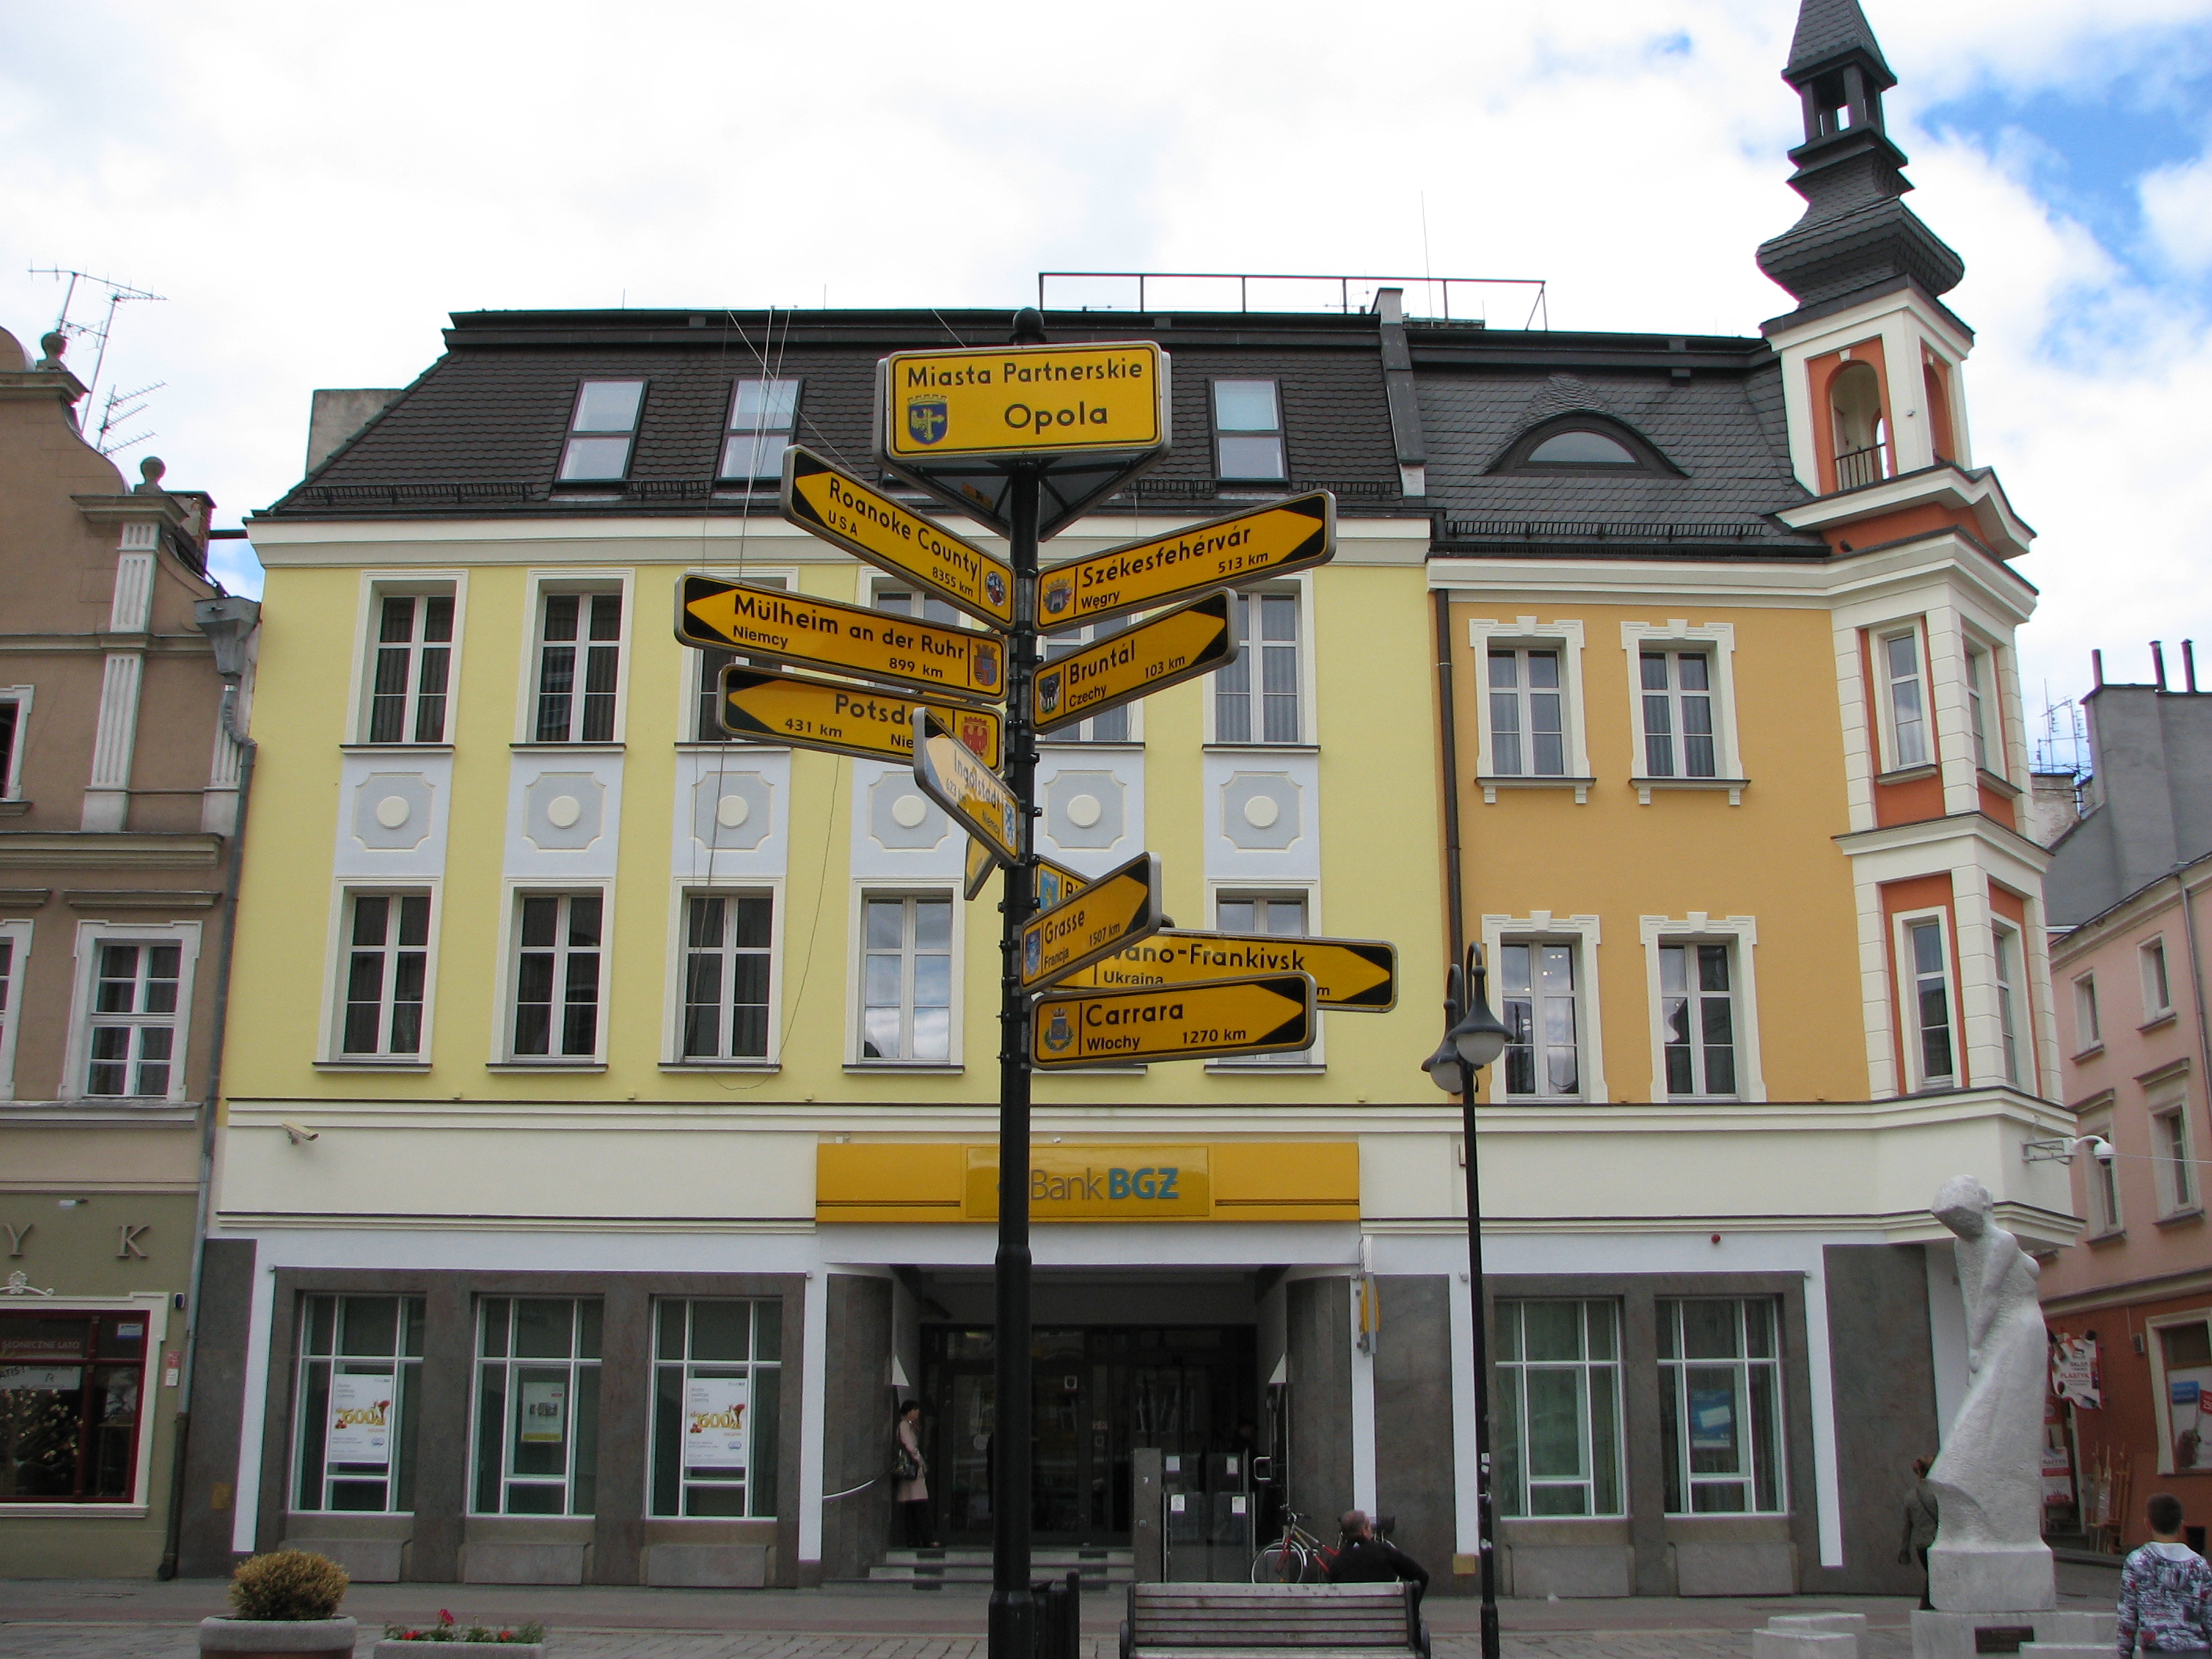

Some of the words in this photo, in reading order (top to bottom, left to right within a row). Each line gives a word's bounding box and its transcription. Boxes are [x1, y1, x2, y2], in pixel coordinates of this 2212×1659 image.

[907, 366, 991, 388] Miasta
[1003, 357, 1143, 383] Partnerskie
[1004, 401, 1108, 435] Opola
[828, 510, 859, 537] USA
[830, 476, 911, 540] Roanoke
[917, 527, 979, 582] County
[1082, 526, 1251, 588] Székesfehérvár
[1218, 556, 1243, 574] 513
[1247, 551, 1269, 566] km
[932, 566, 956, 589] 8355
[959, 580, 974, 598] km
[1080, 589, 1121, 610] Węgry
[732, 624, 789, 650] Niemcy
[733, 594, 839, 635] Mülheim
[849, 625, 873, 642] an
[881, 628, 914, 650] der
[921, 634, 965, 660] Ruhr
[888, 657, 916, 673] 899
[922, 664, 943, 679] km
[1069, 639, 1135, 686] Bruntál
[1144, 661, 1164, 679] 103
[1168, 655, 1185, 669] km
[835, 693, 945, 725] Potsd
[1069, 684, 1108, 708] Czechy
[785, 718, 811, 734] 431
[819, 723, 843, 738] km
[954, 749, 1001, 812] Ingolstadt
[1044, 910, 1086, 945] Grasse
[1108, 922, 1121, 937] km
[1043, 947, 1070, 969] Francja
[1104, 970, 1164, 985] Ukraina
[1086, 1004, 1184, 1027] Carrara
[1087, 1035, 1141, 1051] Włochy
[1182, 1029, 1218, 1045] 1270
[1224, 1029, 1247, 1042] km
[1030, 1167, 1104, 1200] Bank
